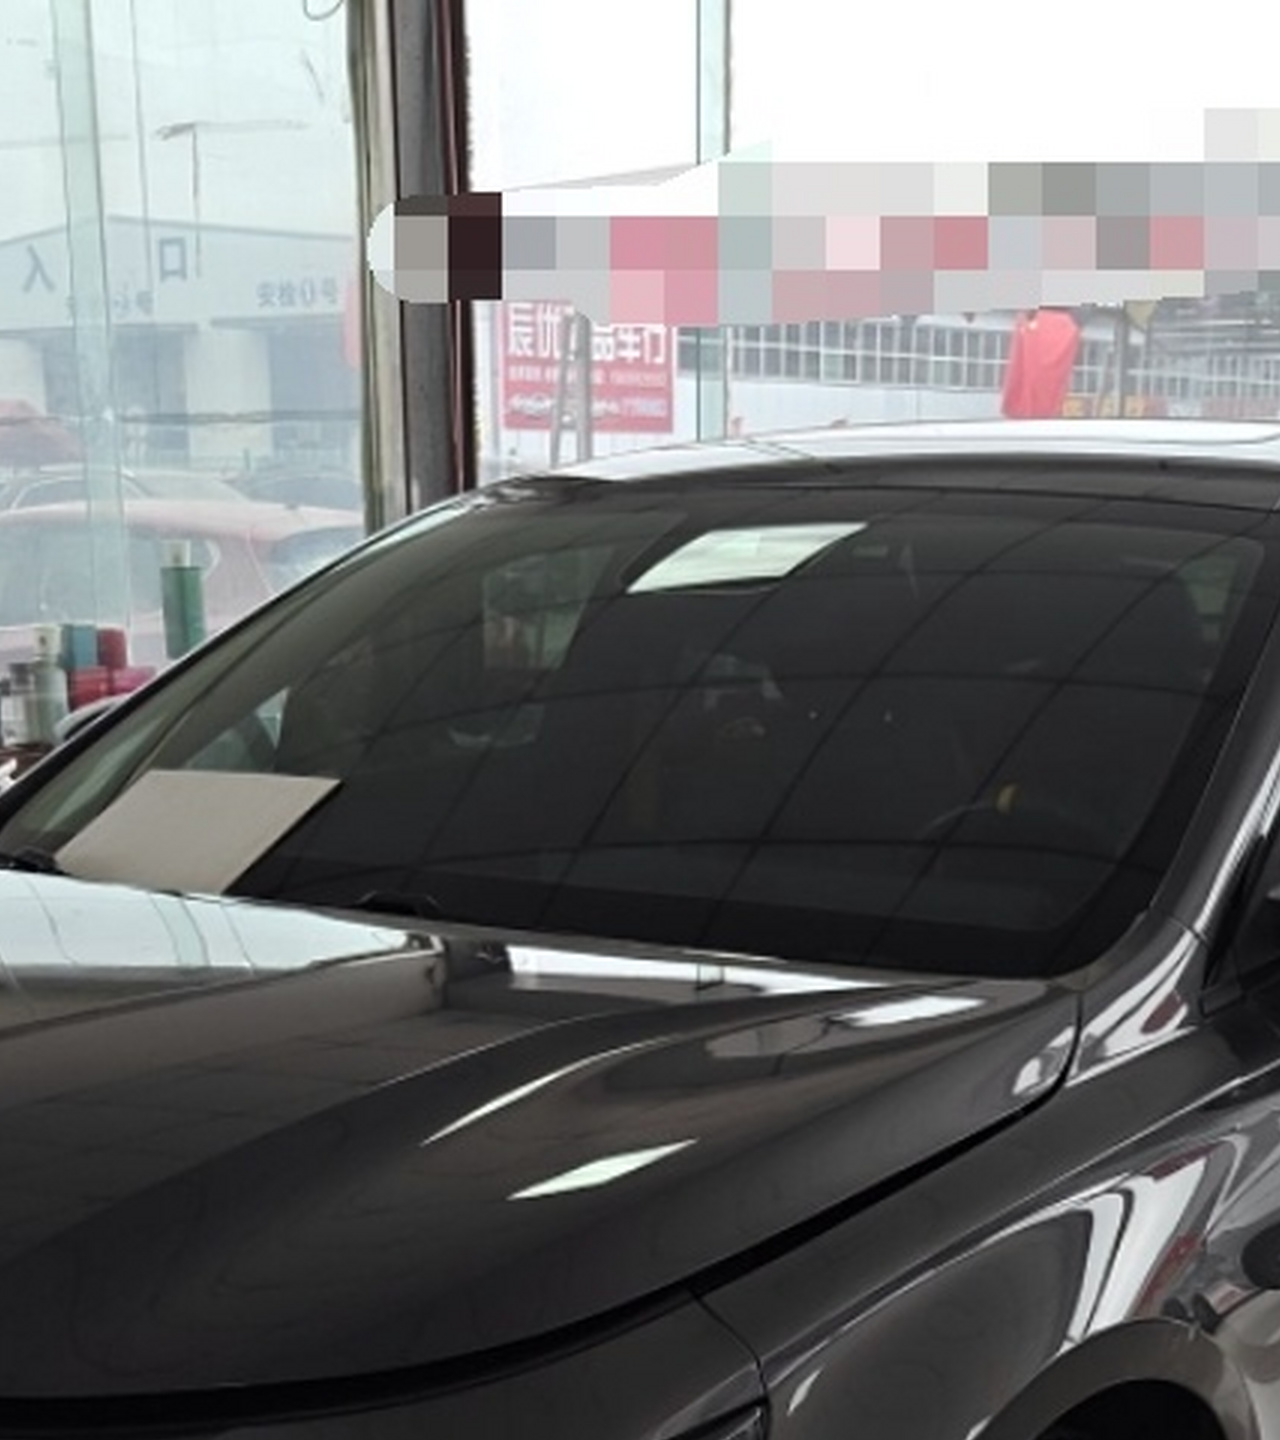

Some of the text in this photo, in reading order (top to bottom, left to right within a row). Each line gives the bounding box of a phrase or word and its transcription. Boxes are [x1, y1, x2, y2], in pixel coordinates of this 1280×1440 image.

[507, 302, 668, 364] 辰优品车行
